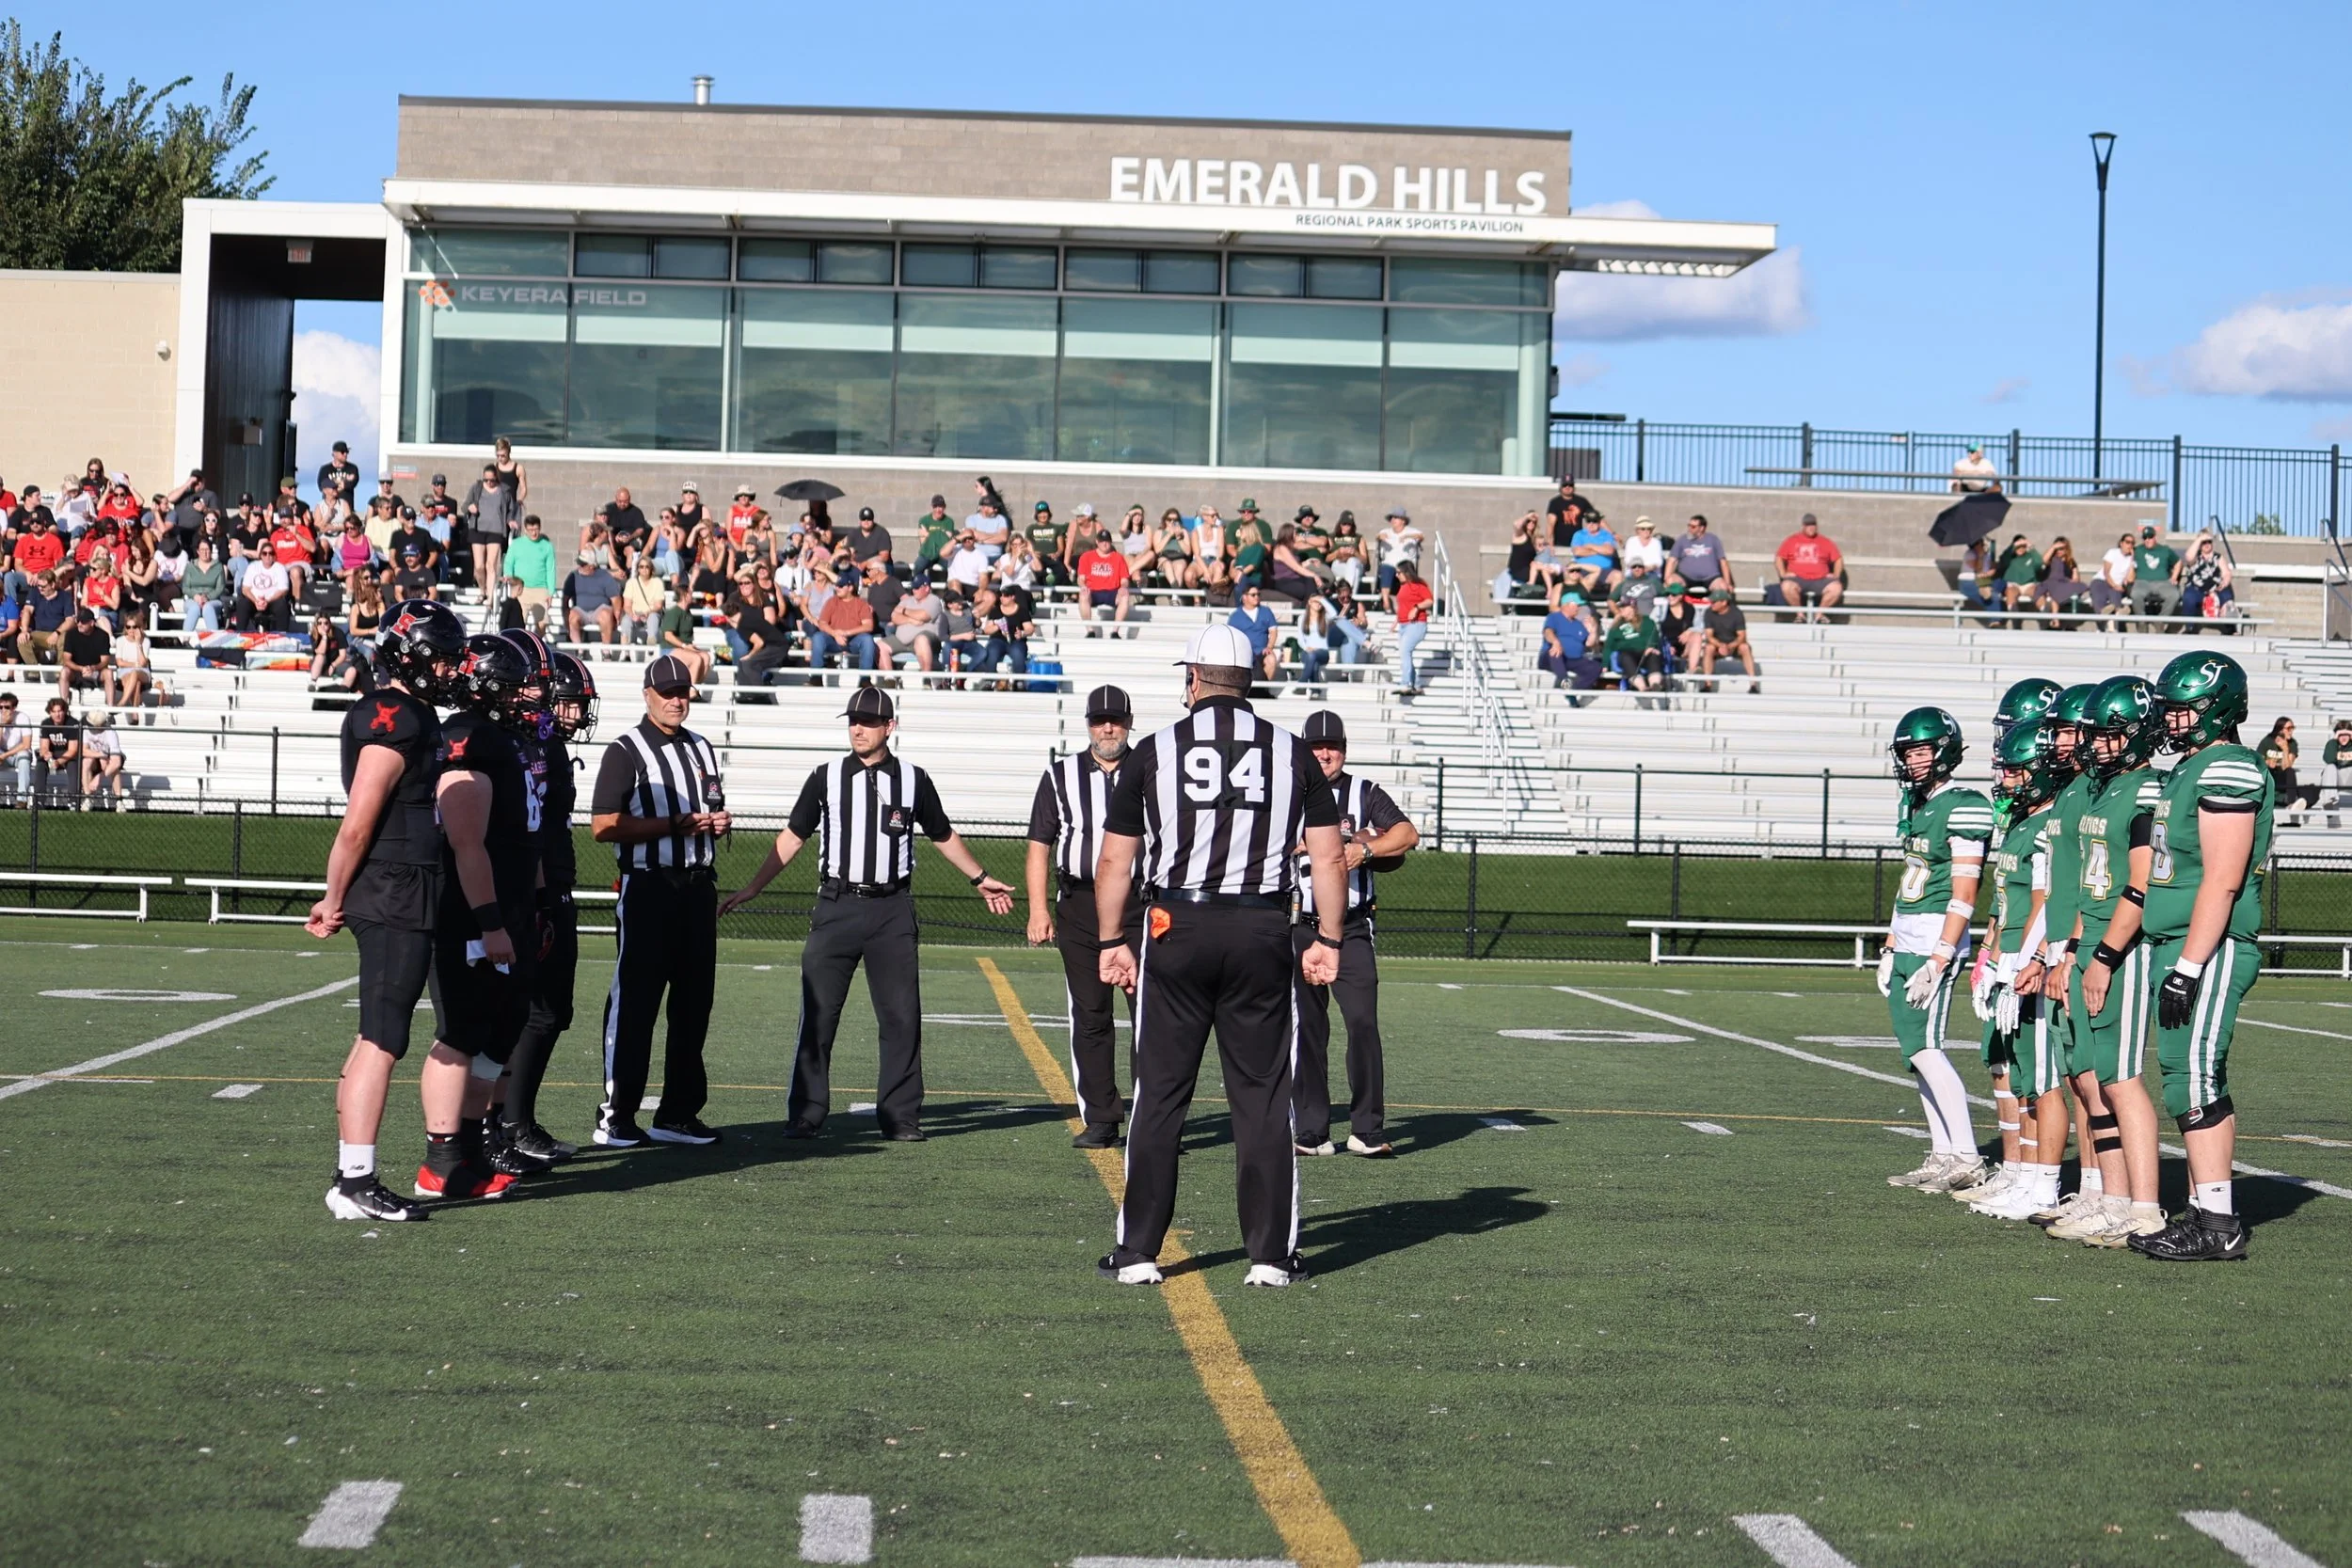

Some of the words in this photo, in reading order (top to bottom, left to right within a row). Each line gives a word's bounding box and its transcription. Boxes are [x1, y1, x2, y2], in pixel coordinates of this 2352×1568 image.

[1110, 156, 1378, 209] EMERALD
[1393, 166, 1547, 214] HILLS
[1295, 214, 1363, 227] REGIONAL
[1367, 216, 1402, 228] PARK
[1406, 217, 1457, 230] SPORTS
[1460, 219, 1523, 232] PAVILION
[461, 286, 567, 303] KEYERA
[573, 289, 647, 306] FIELD
[1184, 746, 1265, 802] 94
[2079, 836, 2112, 900] 4
